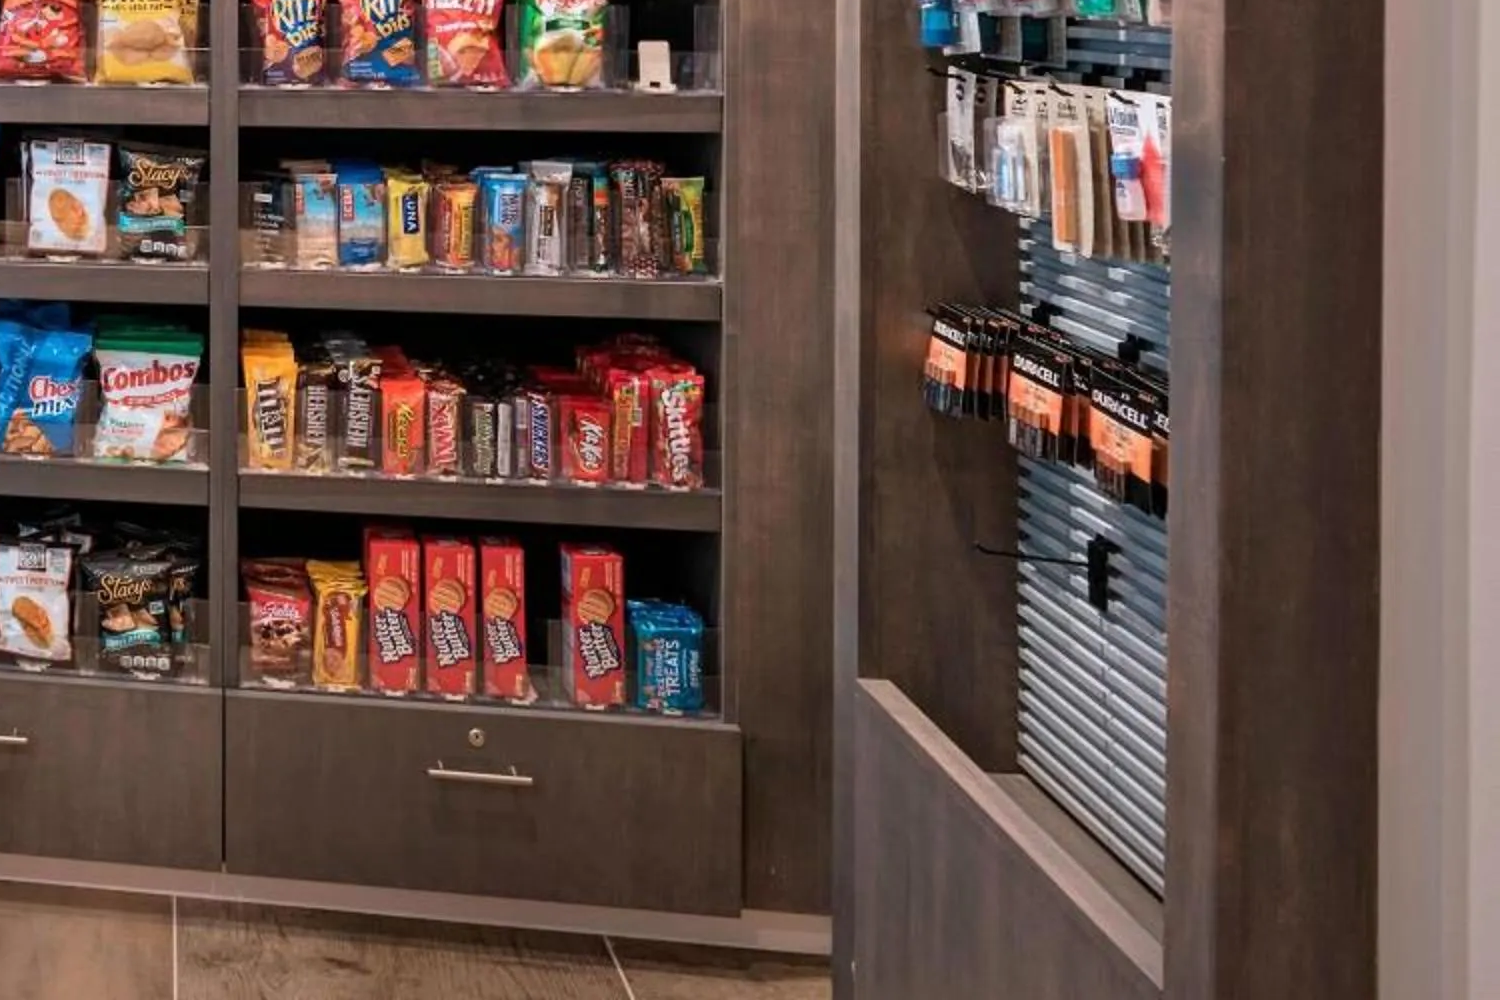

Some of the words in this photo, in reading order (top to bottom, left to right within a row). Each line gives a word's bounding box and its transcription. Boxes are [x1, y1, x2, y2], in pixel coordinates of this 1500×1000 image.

[102, 359, 197, 392] Combos
[1013, 354, 1062, 387] DURACELL
[1092, 388, 1149, 430] DURACELL
[662, 389, 692, 482] Skittles
[98, 574, 151, 605] Stacy's
[375, 614, 400, 663] Nutter
[385, 608, 414, 656] Butter
[430, 616, 456, 667] Nutter
[441, 611, 470, 659] Butter
[497, 618, 521, 658] Butter
[579, 627, 604, 678] Nutter
[590, 621, 619, 670] Butter
[665, 639, 681, 697] TREATS
